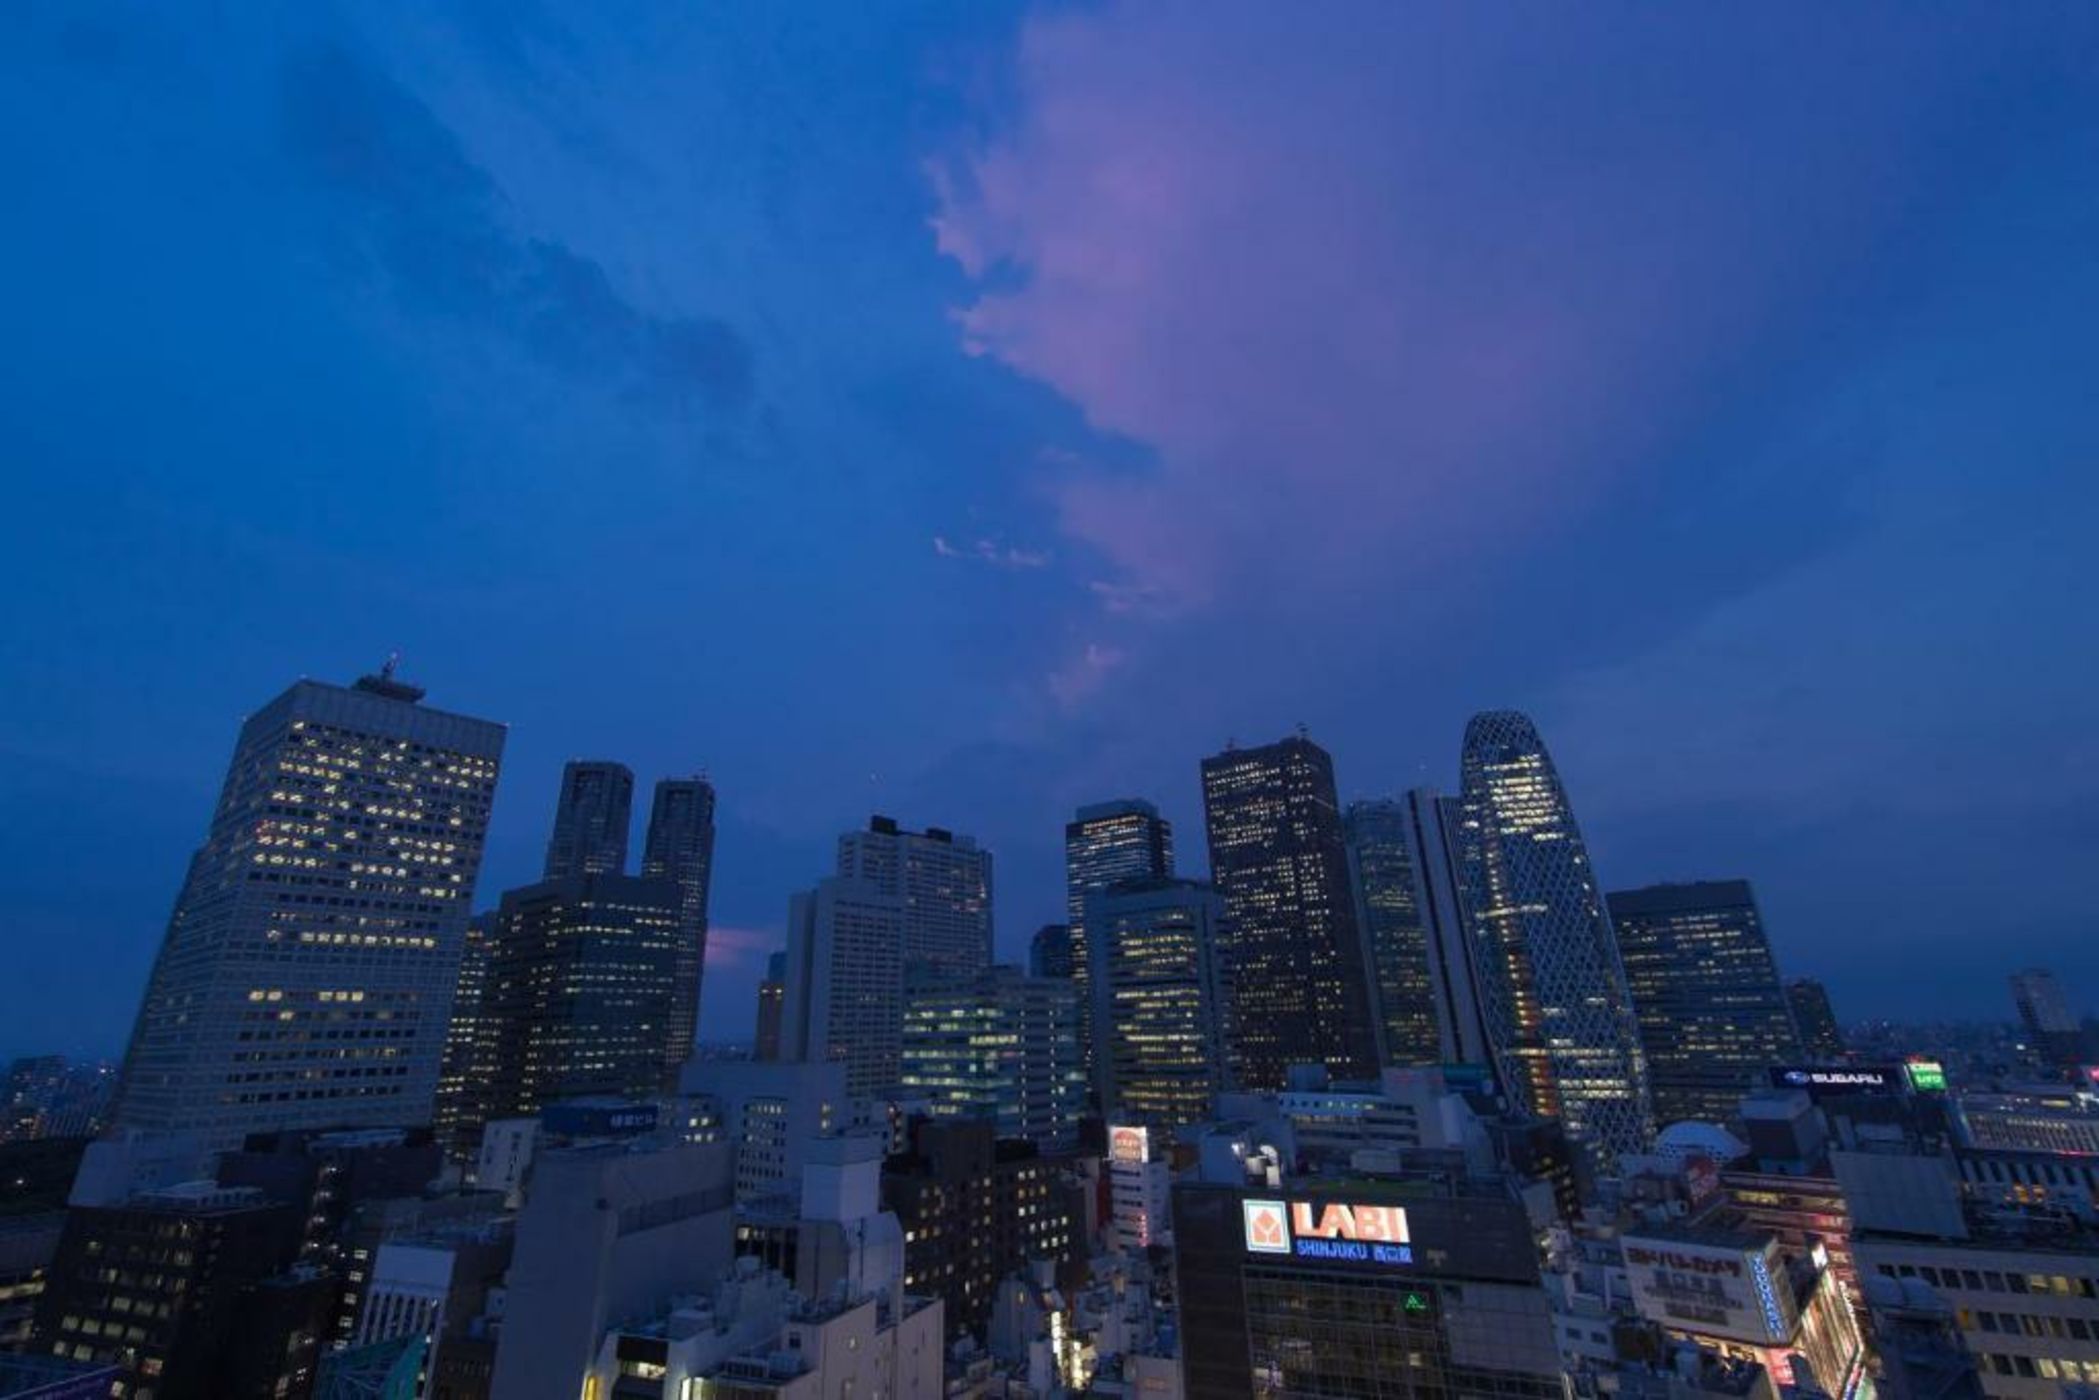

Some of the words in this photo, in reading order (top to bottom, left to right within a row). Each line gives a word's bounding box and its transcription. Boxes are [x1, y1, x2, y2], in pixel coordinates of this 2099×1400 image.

[1811, 1073, 1883, 1085] SUBARU
[1292, 1202, 1410, 1242] LABI
[1296, 1239, 1368, 1260] SHINJUKU
